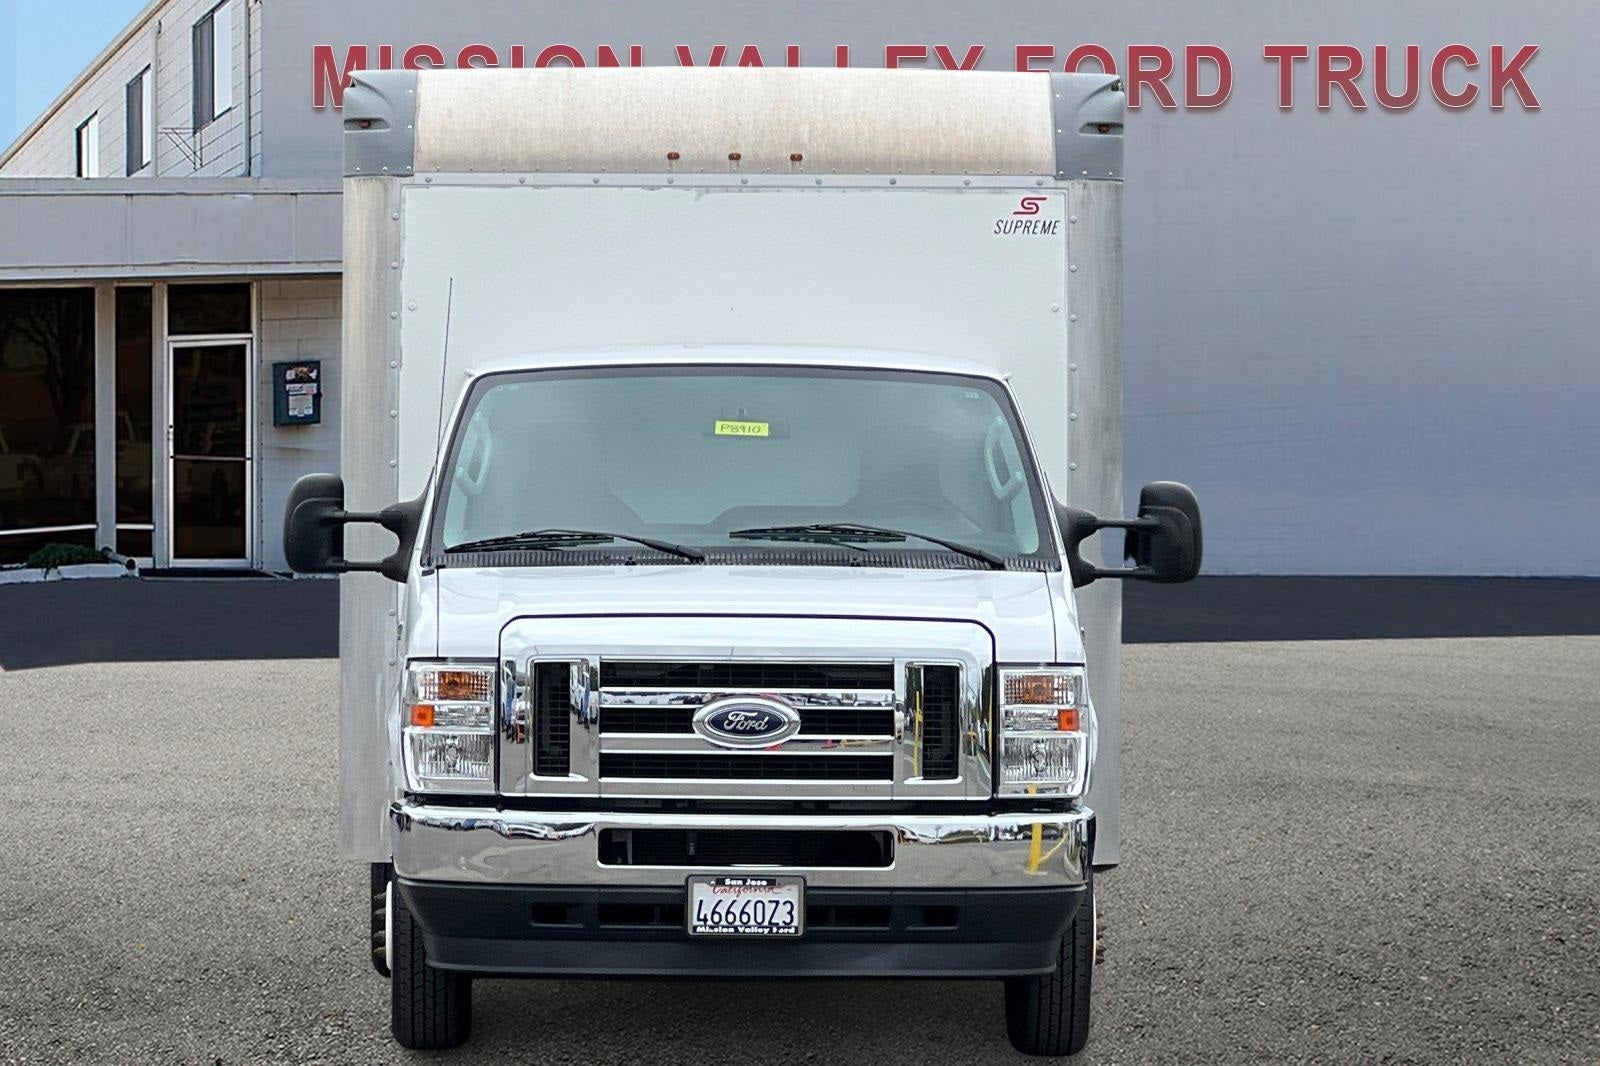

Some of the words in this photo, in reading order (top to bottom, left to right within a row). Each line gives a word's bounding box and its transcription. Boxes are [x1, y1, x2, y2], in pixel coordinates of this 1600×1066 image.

[1263, 44, 1542, 109] TRUCK
[994, 219, 1060, 235] SUPREME
[724, 712, 769, 731] Ford
